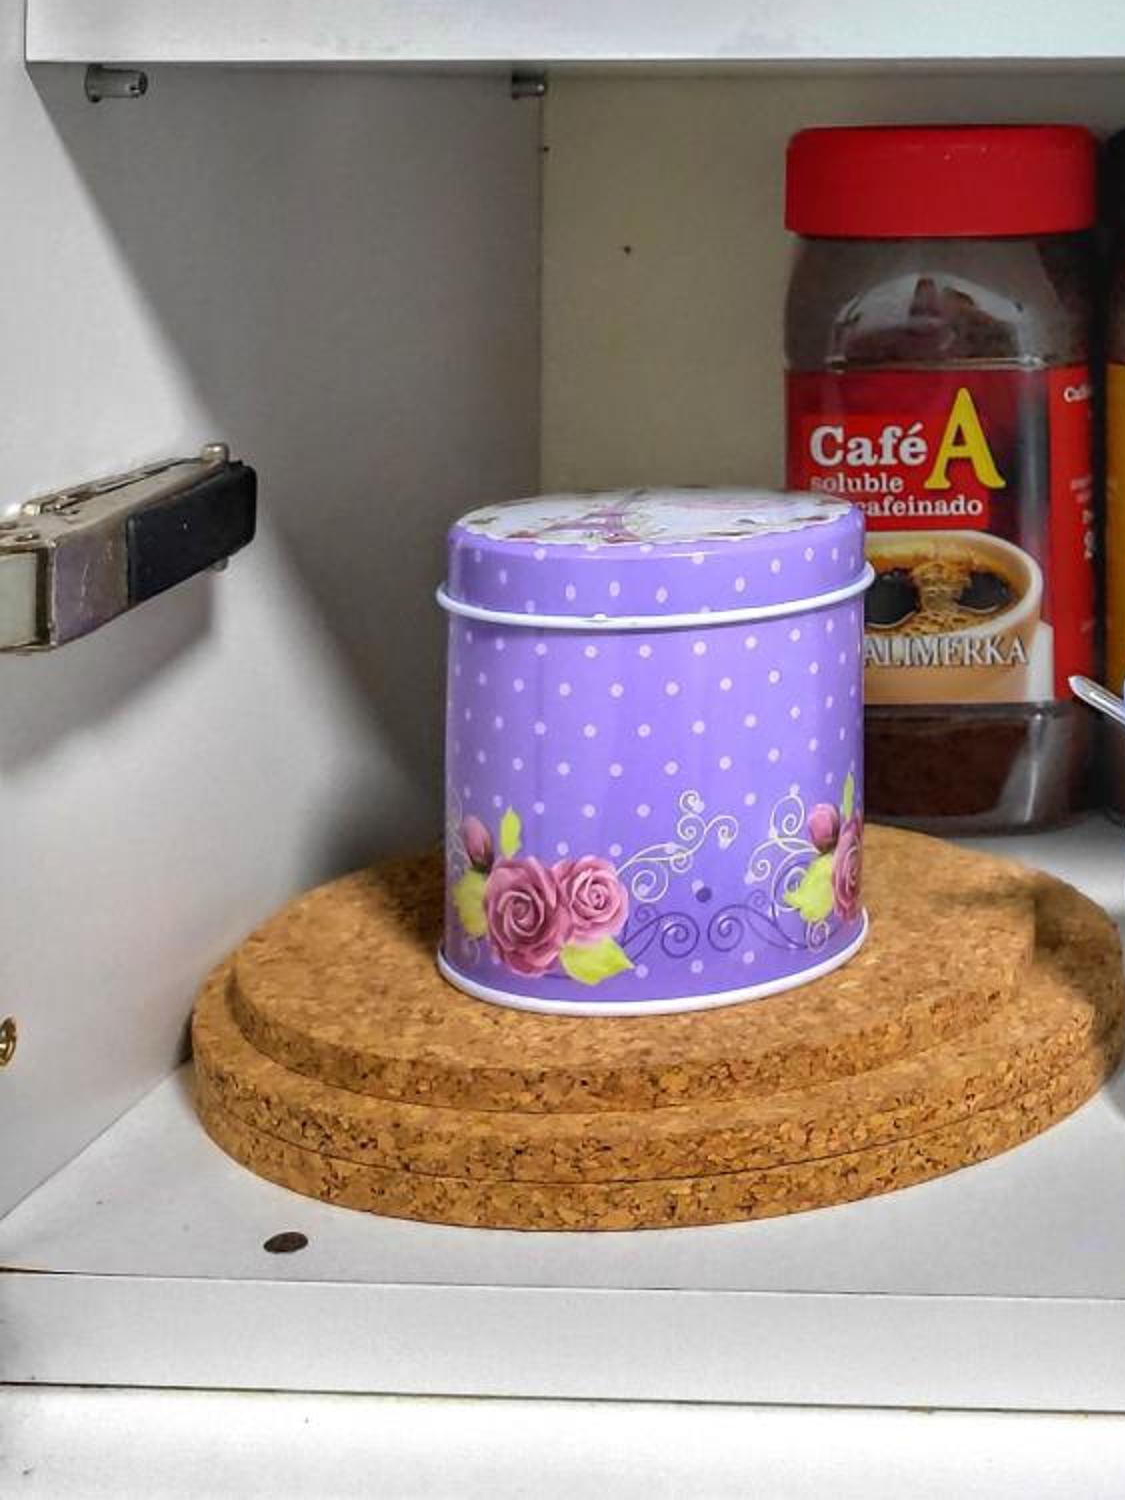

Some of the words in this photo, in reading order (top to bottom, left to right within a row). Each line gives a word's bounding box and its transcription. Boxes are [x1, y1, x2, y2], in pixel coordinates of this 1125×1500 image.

[810, 423, 928, 466] Café
[924, 387, 1006, 489] A
[811, 472, 904, 493] soluble
[855, 495, 984, 517] cafeinado
